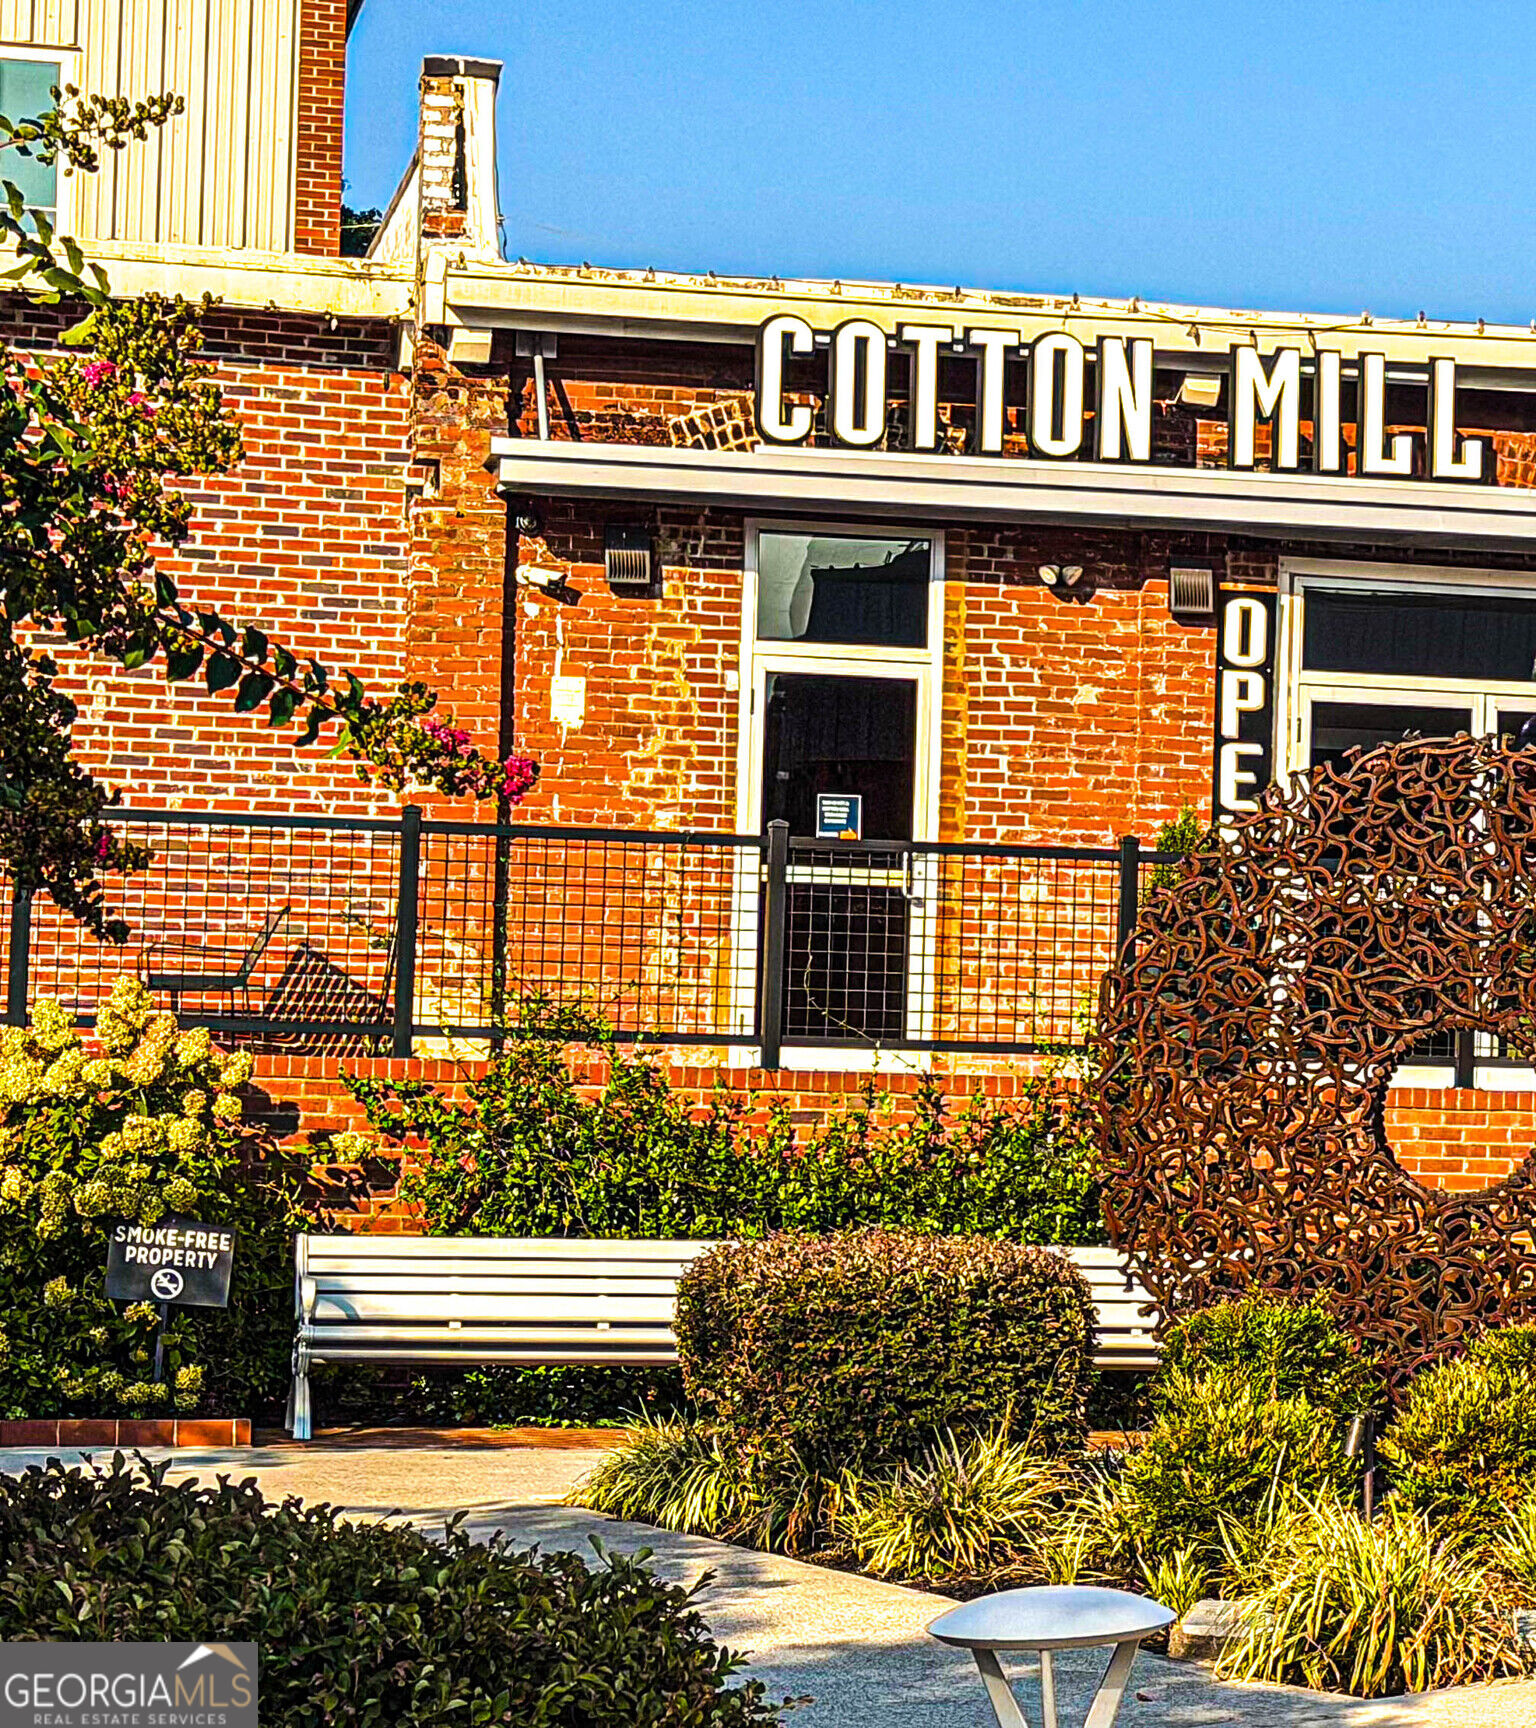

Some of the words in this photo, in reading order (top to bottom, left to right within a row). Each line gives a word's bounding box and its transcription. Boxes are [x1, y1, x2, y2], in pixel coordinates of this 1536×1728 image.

[759, 314, 1153, 462] COTTON
[1233, 346, 1484, 478] MILL
[114, 1225, 232, 1252] SMOKE-FREE
[124, 1245, 218, 1269] PROPERTY
